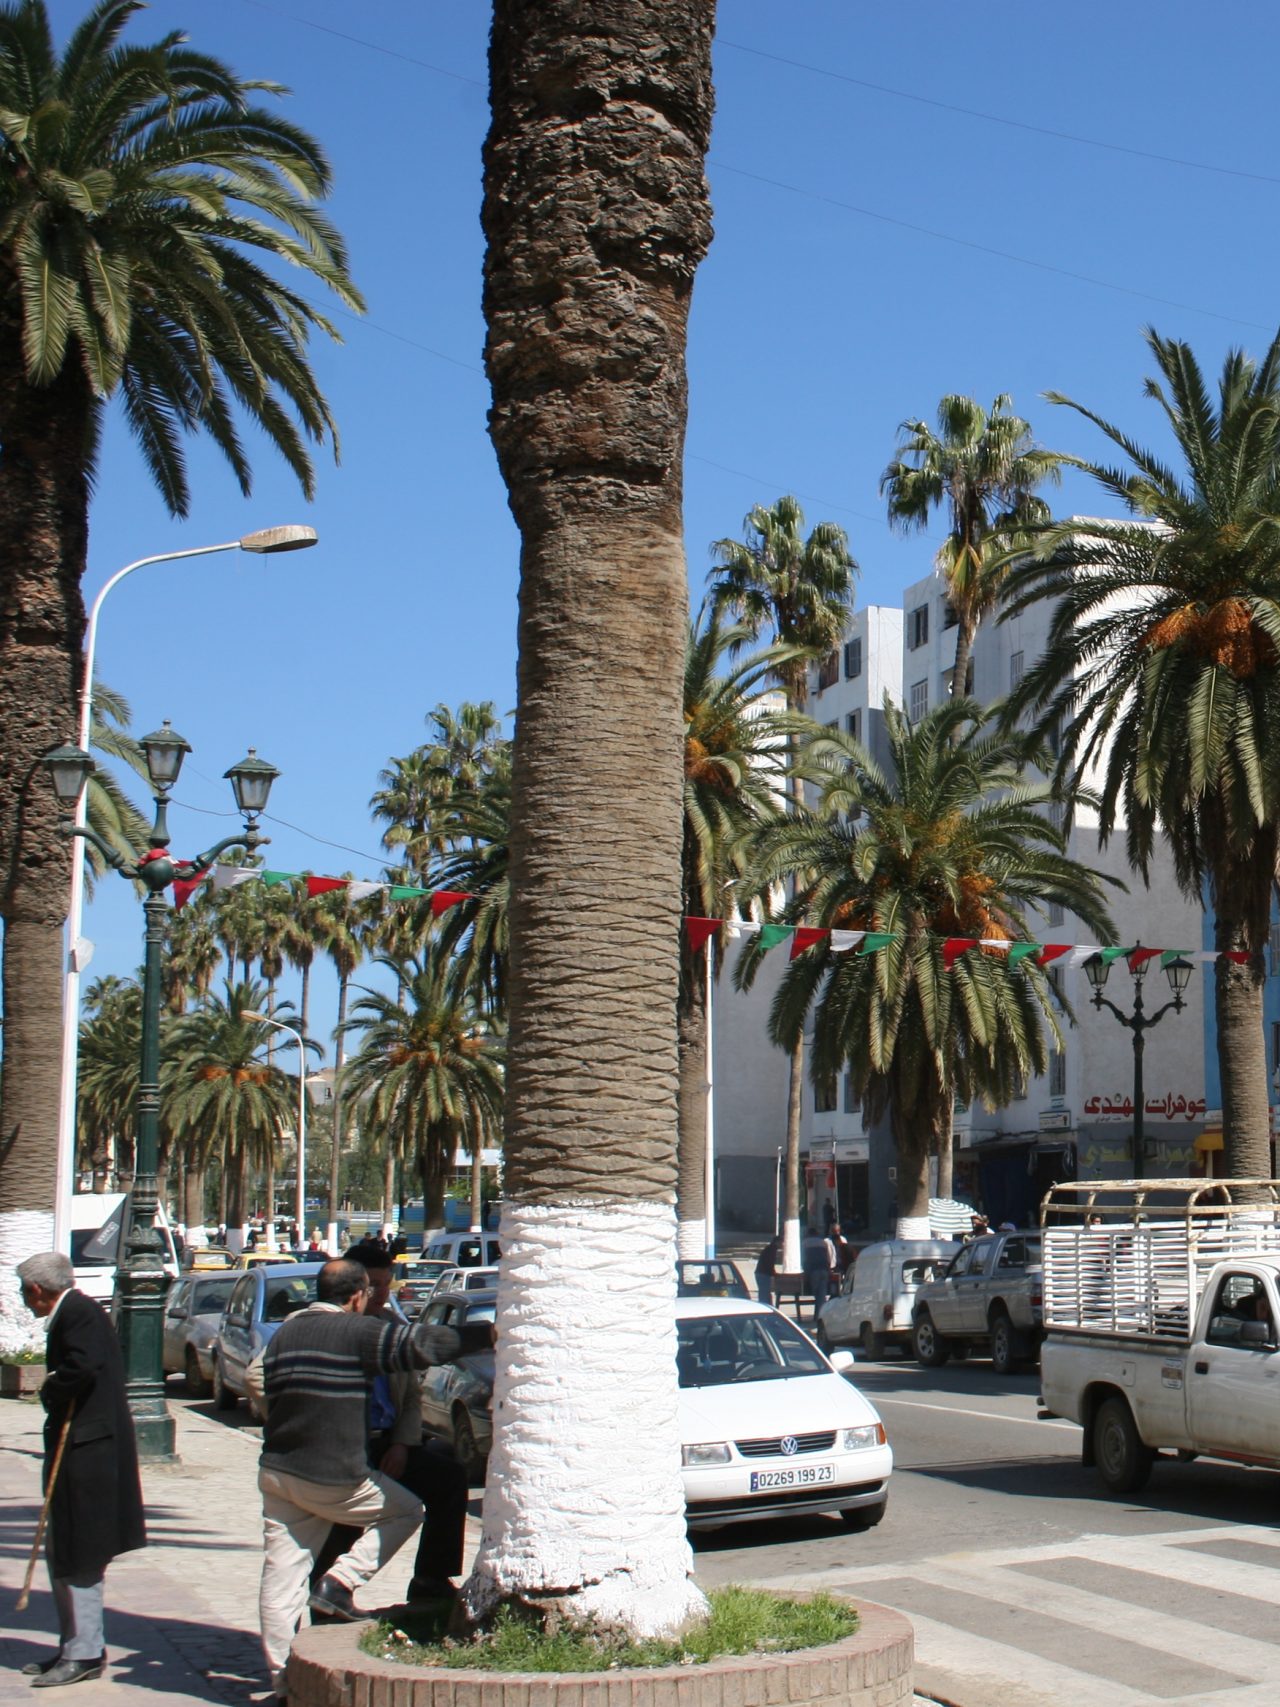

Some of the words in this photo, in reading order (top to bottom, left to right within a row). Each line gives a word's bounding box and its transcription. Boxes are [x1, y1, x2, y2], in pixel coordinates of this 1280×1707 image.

[759, 1471, 794, 1486] 02269
[797, 1469, 815, 1483] 199
[818, 1466, 832, 1480] 23
